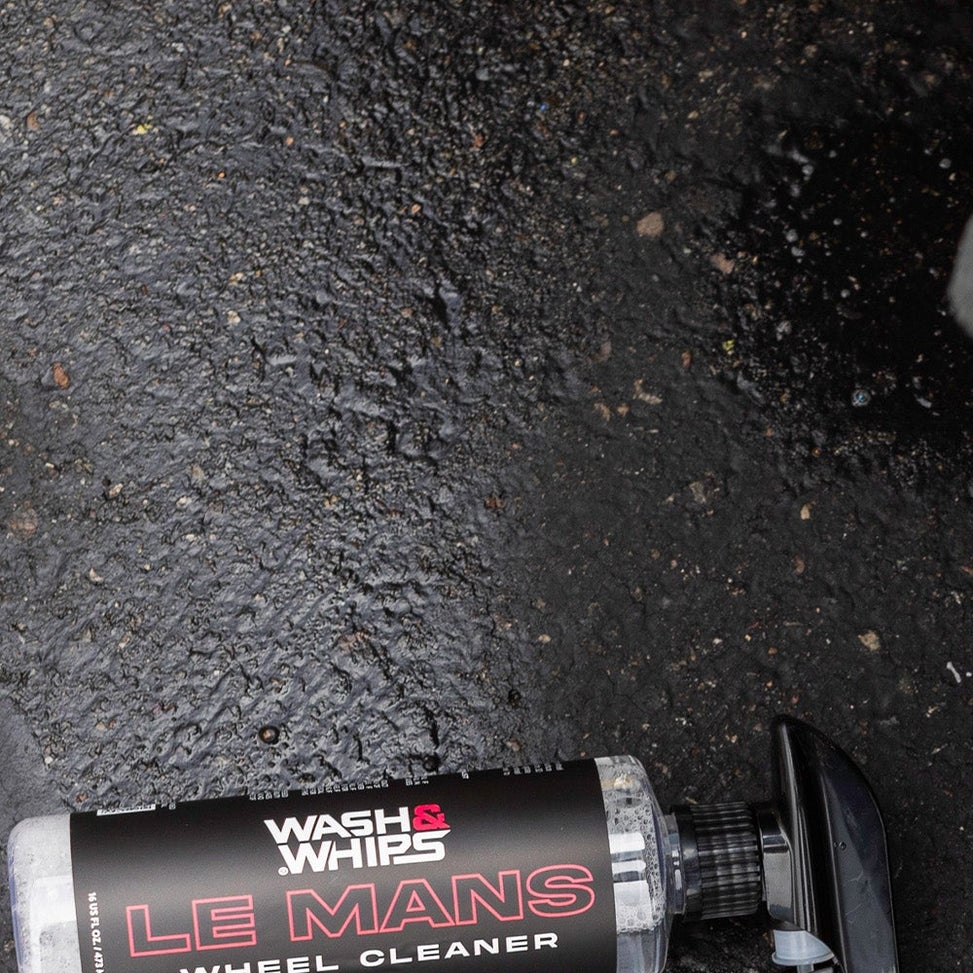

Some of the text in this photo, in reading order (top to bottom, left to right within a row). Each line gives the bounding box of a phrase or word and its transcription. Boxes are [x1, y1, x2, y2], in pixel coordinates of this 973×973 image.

[264, 804, 450, 844] WASH&
[278, 829, 451, 875] WHIPS
[88, 892, 97, 902] 16
[89, 903, 99, 916] US
[126, 864, 596, 957] LE MANS
[90, 917, 100, 929] FL
[94, 951, 104, 969] 473
[360, 932, 559, 968] CLEANER
